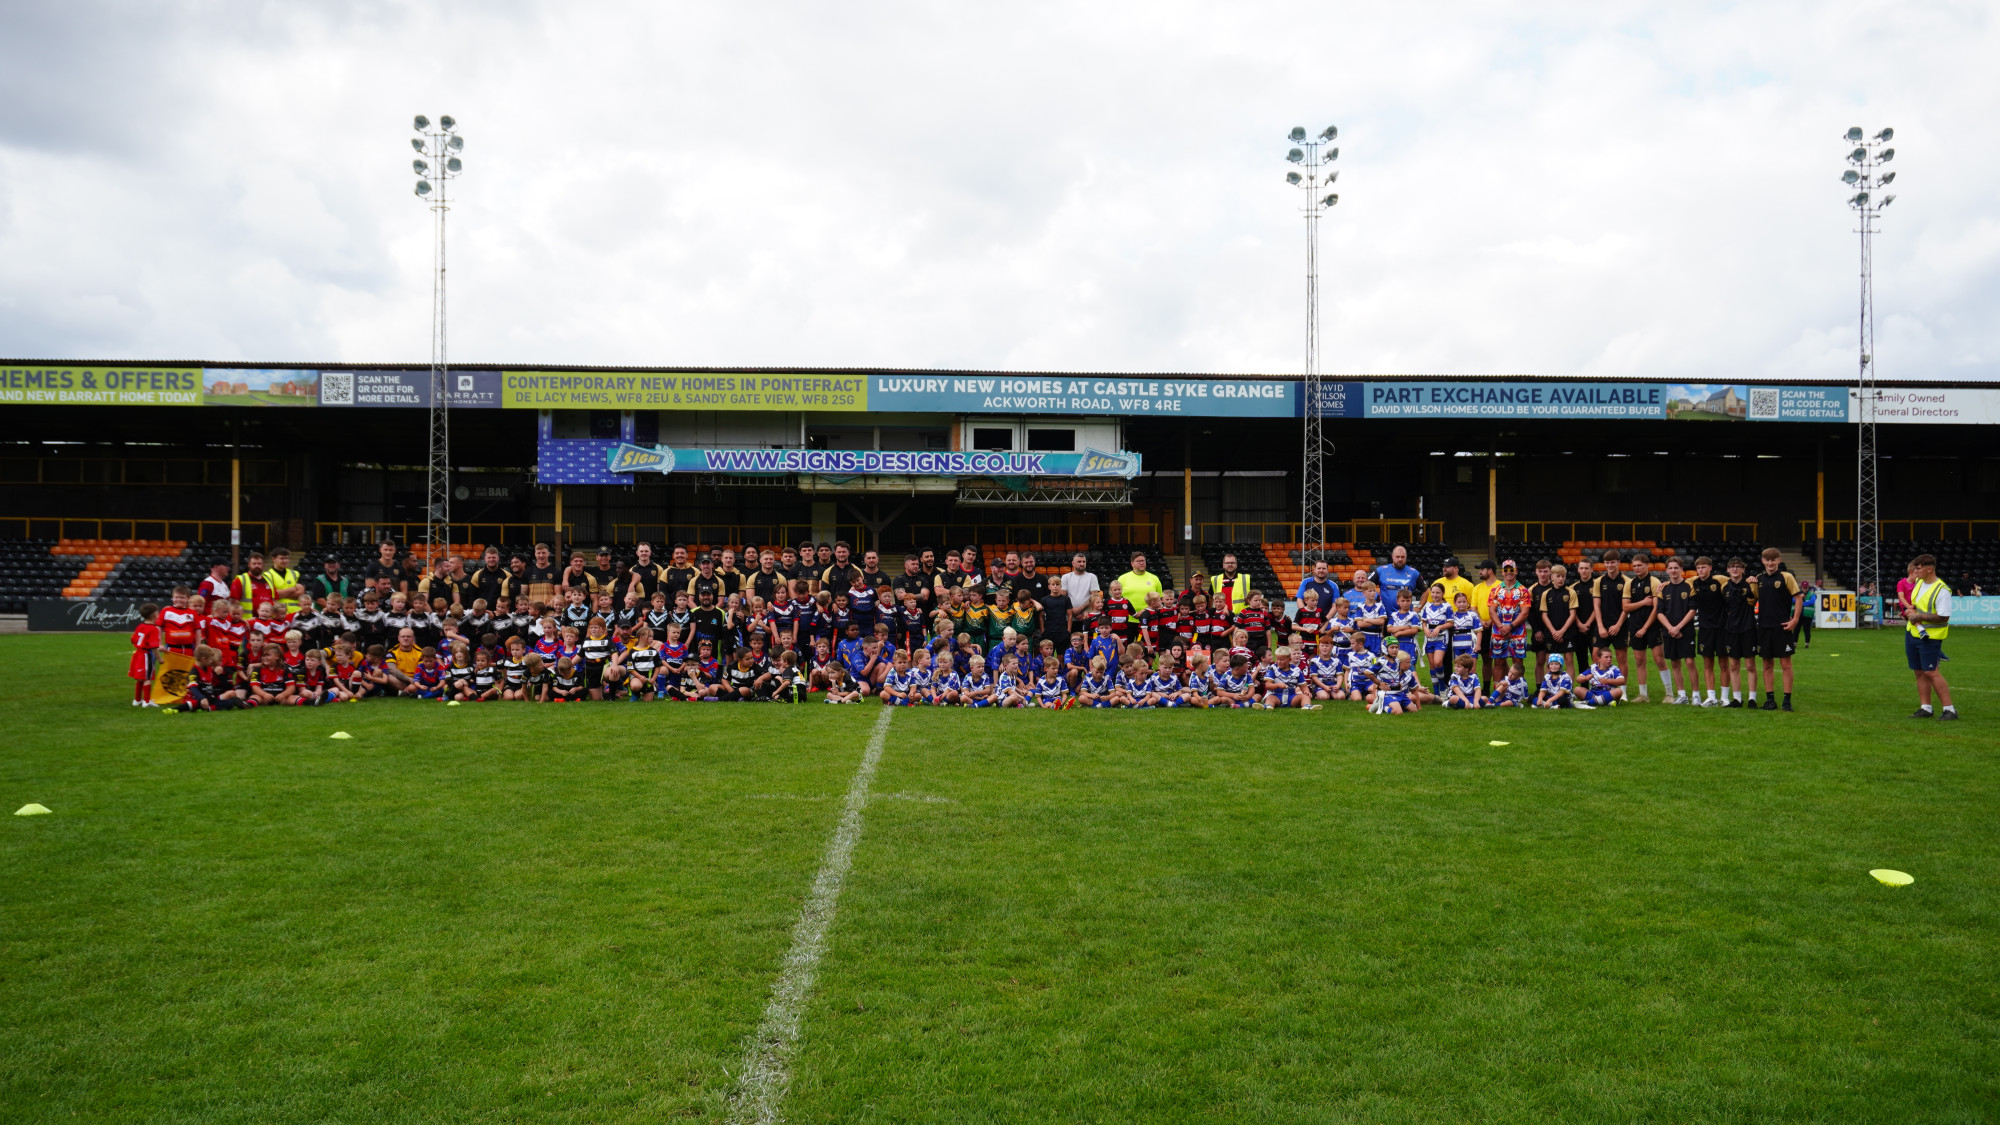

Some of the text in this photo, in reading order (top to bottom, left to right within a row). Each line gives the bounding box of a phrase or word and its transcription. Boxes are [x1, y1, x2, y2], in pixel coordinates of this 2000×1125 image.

[81, 371, 98, 389] &
[105, 371, 195, 390] OFFERS
[358, 376, 400, 384] SCAN THE
[508, 376, 862, 392] CONTEMPORARY NEW HOMES IN PONTEFRACT
[358, 385, 414, 394] QR CODE FOR
[878, 378, 1284, 398] LUXURY NEW HOMES AT CASTLE SYKE GRANGE
[1316, 384, 1344, 392] DAVID
[26, 390, 56, 401] NEW
[58, 391, 117, 402] BARRATT
[119, 392, 156, 402] HOME
[157, 392, 198, 402] TODAY
[358, 394, 420, 403] MORE DETAILS
[516, 392, 855, 406] DE LACY MEWS, WF8 2EU & SANDY GATE VIEW, WF8 2SG
[1374, 388, 1660, 404] PART EXCHANGE AVAILABLE
[1874, 393, 1945, 404] amily Owned
[984, 396, 1182, 411] ACKWORTH ROAD, WF8 4RE
[1316, 400, 1344, 408] HOMES
[1782, 400, 1794, 408] QR
[1796, 400, 1822, 408] CODE
[1372, 406, 1660, 415] DAVID WILSON HOMES COULD BE YOUR GUARANTEED BUYER
[1782, 409, 1844, 418] MORE DETAILS
[1912, 408, 1959, 416] Directors
[620, 450, 660, 466] SIGNS
[704, 450, 1046, 473] WWW.SIGNS-DESIGNS.CO.UK
[1085, 456, 1124, 471] SIGNS
